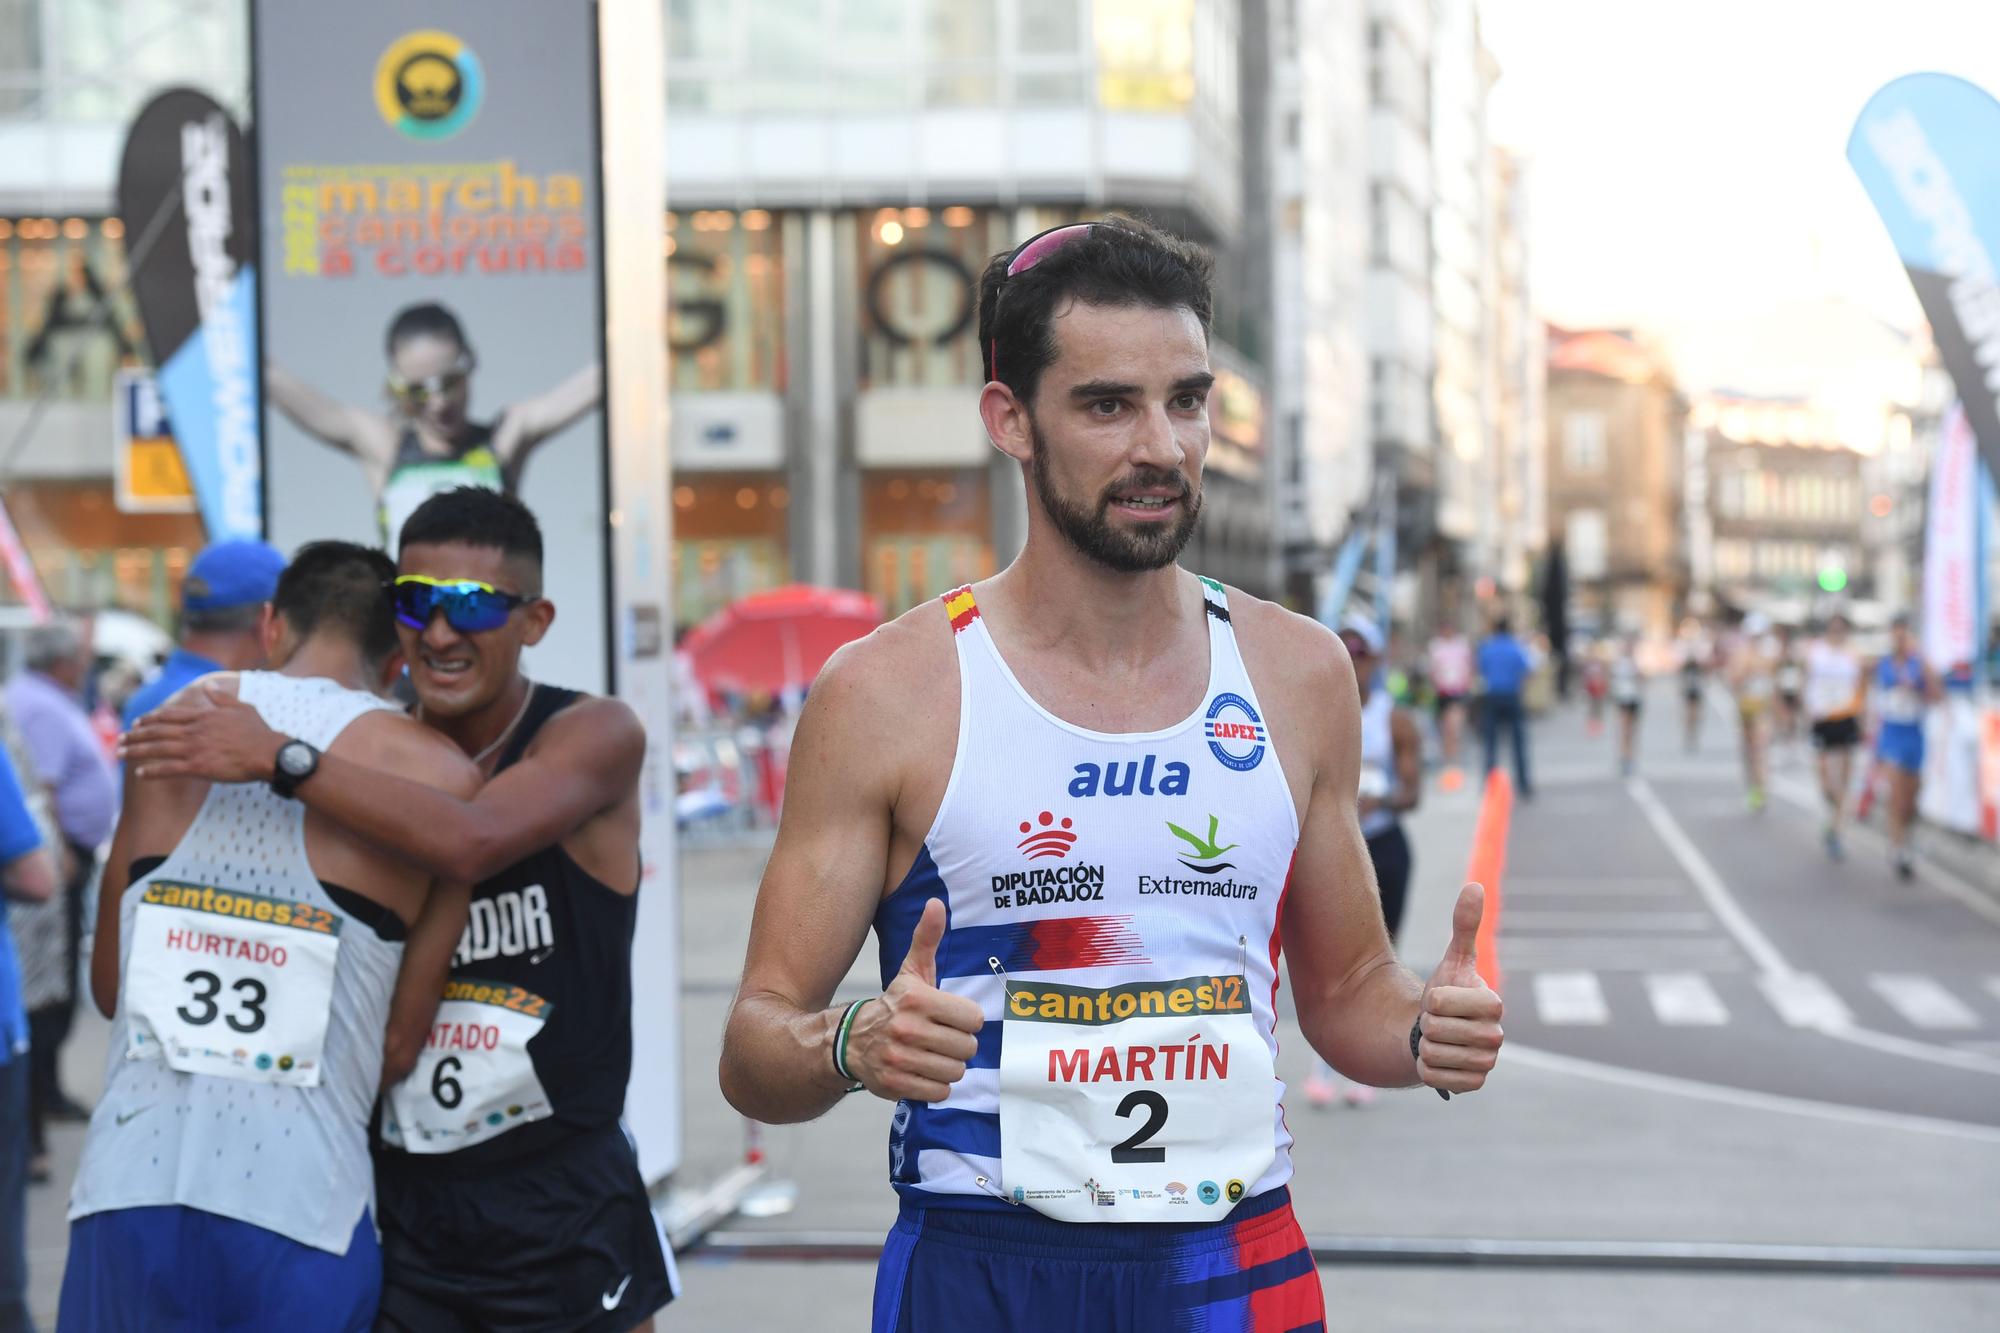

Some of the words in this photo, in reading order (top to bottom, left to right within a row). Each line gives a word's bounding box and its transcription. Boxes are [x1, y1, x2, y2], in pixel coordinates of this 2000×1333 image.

[319, 161, 584, 213] marcha
[319, 209, 586, 247] cantones
[1214, 722, 1257, 741] CAPEX
[1068, 754, 1190, 798] aula
[991, 861, 1104, 893] DIPUTACIÓN
[994, 896, 1011, 909] DE
[1016, 883, 1104, 907] BADAJOZ
[1138, 876, 1258, 901] Extremadura
[452, 883, 555, 968] ADOR
[167, 928, 288, 968] HURTADO
[176, 970, 267, 1034] 33
[1048, 1033, 1230, 1083] MARTÍN
[431, 1055, 463, 1110] 6
[1110, 1090, 1169, 1164] 2
